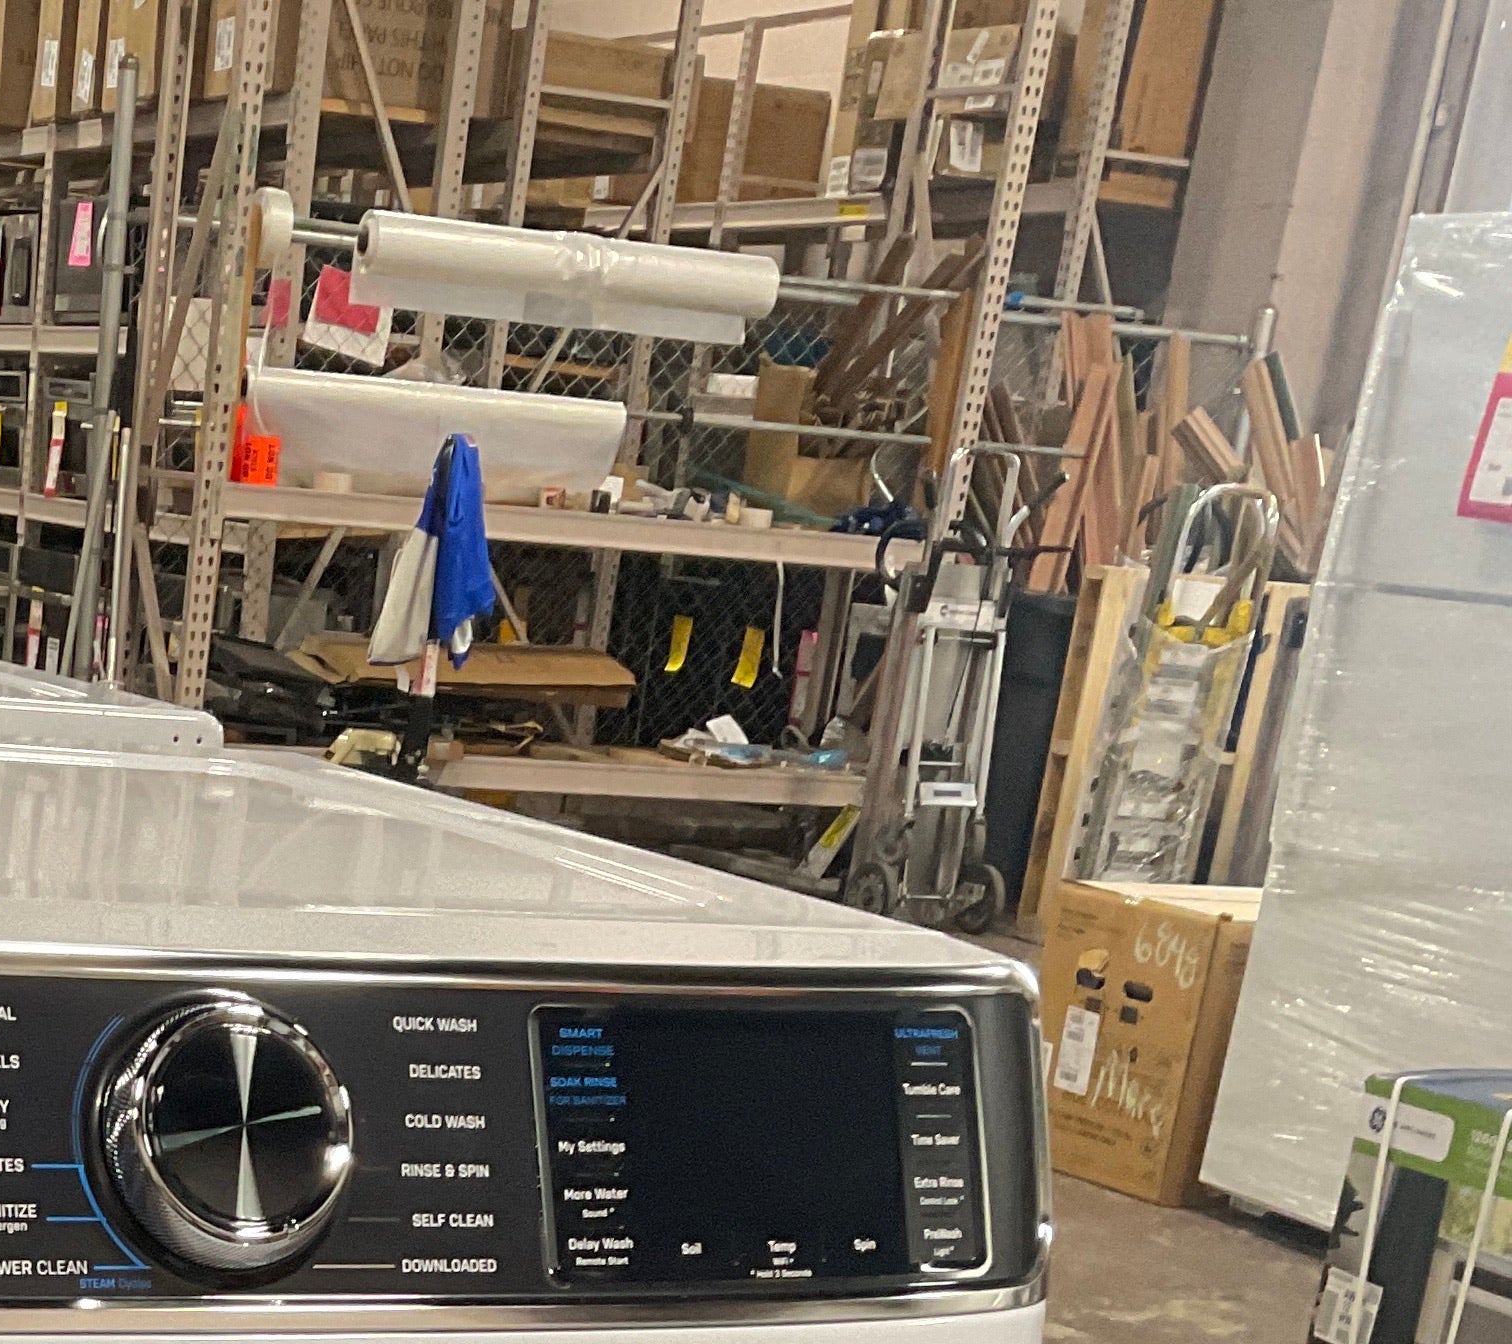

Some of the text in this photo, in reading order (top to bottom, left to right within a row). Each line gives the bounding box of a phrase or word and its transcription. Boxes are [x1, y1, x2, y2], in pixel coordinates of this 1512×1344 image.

[392, 1015, 478, 1033] QUICK WASH
[408, 1063, 482, 1080] DELICATES
[404, 1113, 486, 1129] COLD WASH
[557, 1140, 626, 1156] My Settings
[400, 1163, 490, 1178] RINSE & SPIN
[563, 1187, 629, 1201] More Water
[411, 1213, 494, 1228] SELF CLEAN
[567, 1236, 634, 1253] Delay Wash
[36, 1259, 89, 1276] CLEAN
[401, 1258, 498, 1273] DOWNLOADED
[79, 1277, 116, 1289] STEAM
